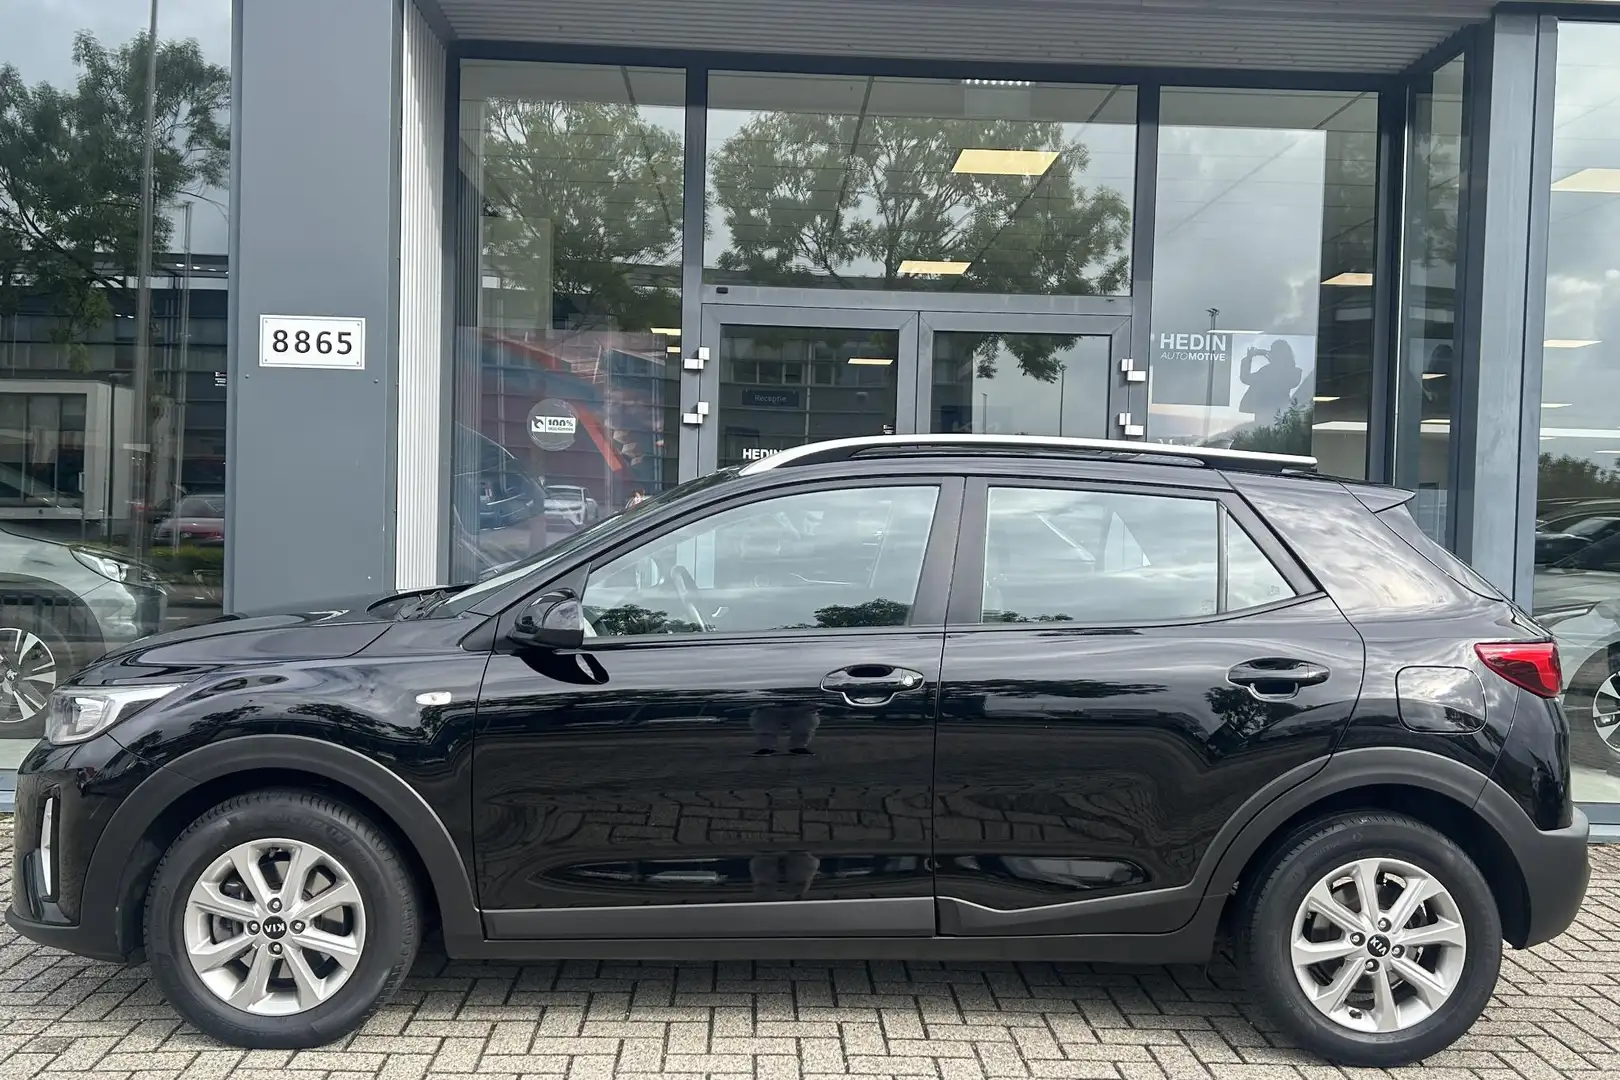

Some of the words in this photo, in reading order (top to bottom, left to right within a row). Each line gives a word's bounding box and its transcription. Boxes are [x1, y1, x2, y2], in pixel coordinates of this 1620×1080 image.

[272, 329, 352, 355] 8865
[1160, 333, 1226, 351] HEDIN
[1160, 352, 1226, 362] AUTOMOTIVE
[264, 922, 286, 933] KIA
[1370, 936, 1387, 956] KIA
